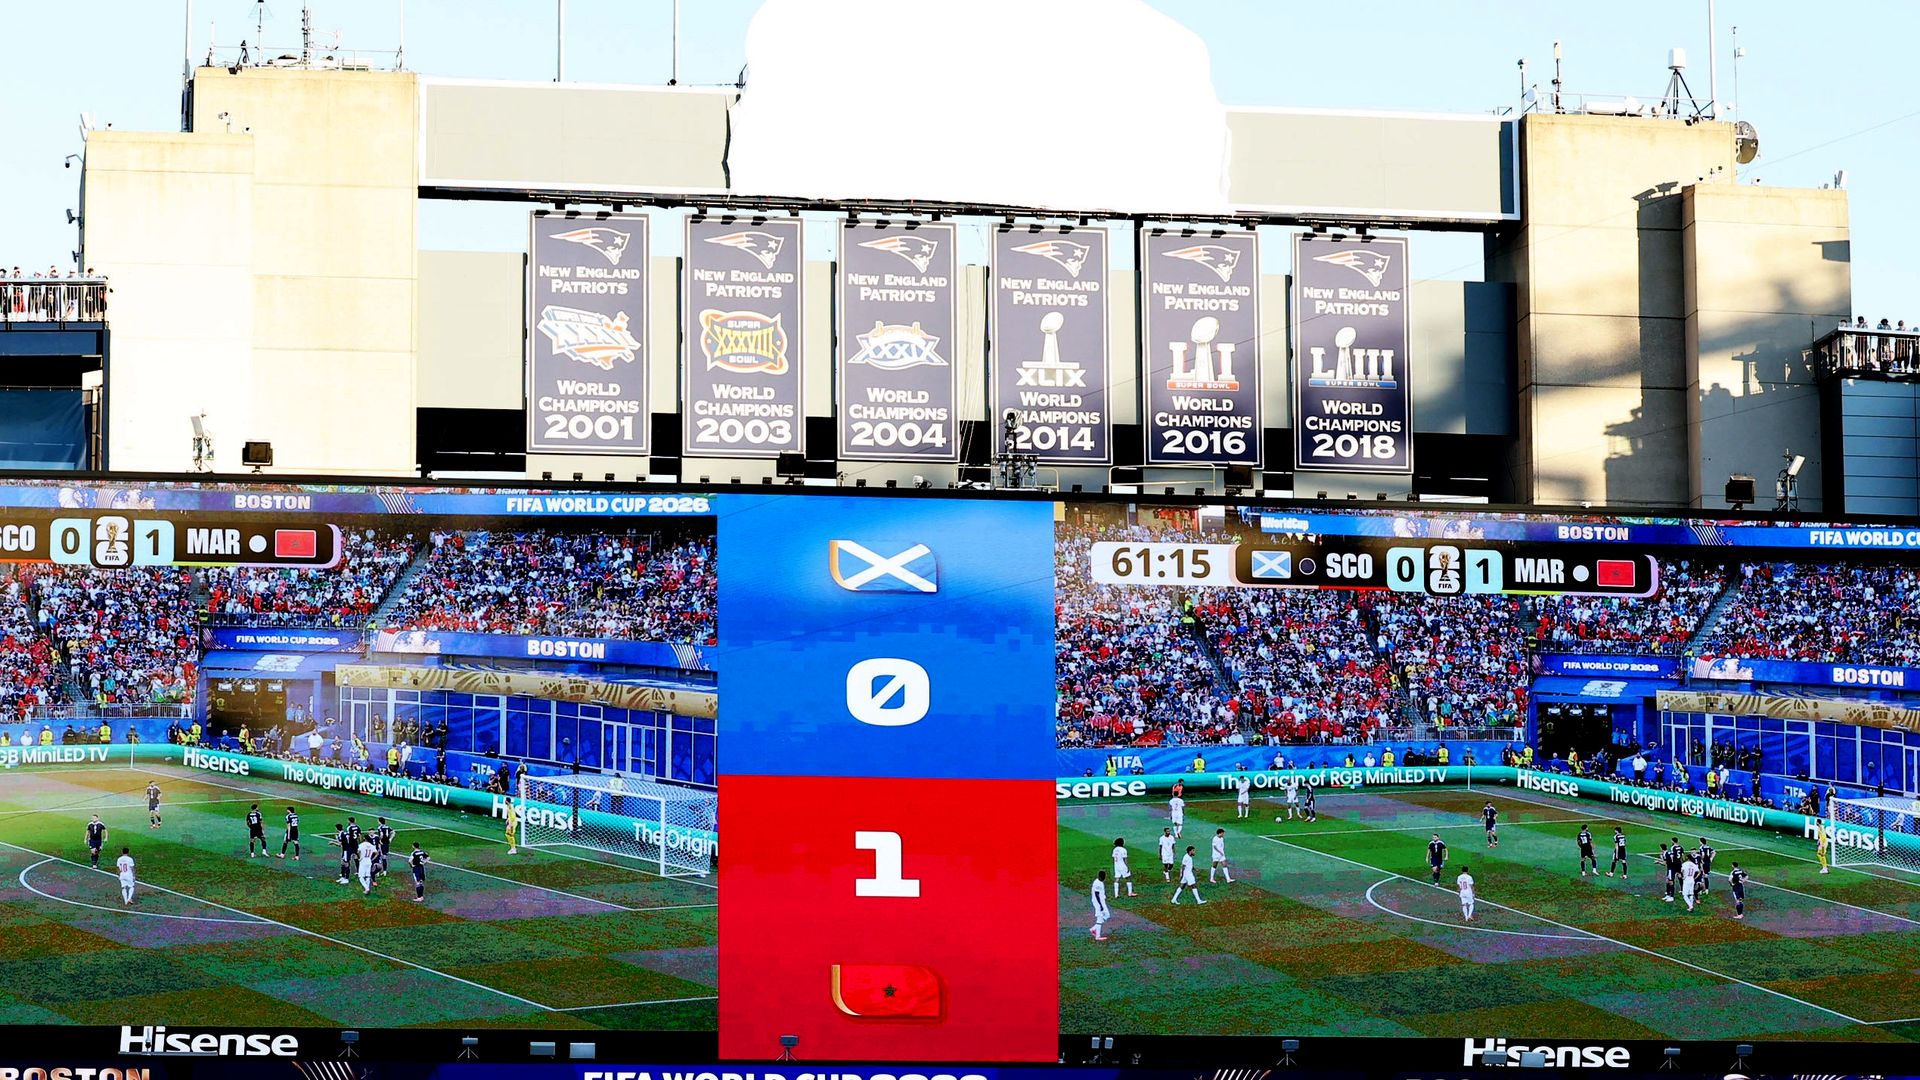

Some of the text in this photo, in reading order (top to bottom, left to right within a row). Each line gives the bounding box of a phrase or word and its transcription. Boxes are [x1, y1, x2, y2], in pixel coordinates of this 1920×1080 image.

[539, 265, 640, 280] NEW ENGLAND
[694, 269, 794, 284] NEW ENGLAND
[848, 273, 947, 288] NEW ENGLAND
[551, 280, 628, 295] PATRIOTS
[705, 284, 782, 299] PATRIOTS
[1001, 277, 1099, 292] NEW ENGLAND
[1153, 283, 1250, 297] NEW ENGLAND
[860, 287, 936, 302] PATRIOTS
[1012, 291, 1088, 306] PATRIOTS
[1304, 287, 1400, 301] NEW ENGLAND
[1165, 296, 1239, 311] PATRIOTS
[1315, 301, 1389, 316] PATRIOTS
[727, 320, 761, 328] SUPER
[729, 355, 759, 364] BOWL
[1015, 368, 1087, 387] XLIX
[557, 380, 621, 396] WORLD
[712, 384, 775, 400] WORLD
[866, 388, 929, 403] WORLD
[539, 397, 639, 414] CHAMPIONS
[1020, 391, 1082, 407] WORLD
[1172, 396, 1234, 411] WORLD
[694, 401, 794, 417] CHAMPIONS
[849, 404, 947, 421] CHAMPIONS
[1322, 400, 1383, 416] WORLD
[544, 415, 634, 440] 2001
[1155, 412, 1252, 428] CHAMPIONS
[1305, 416, 1401, 432] CHAMPIONS
[696, 418, 792, 444] 2003
[850, 422, 947, 448] 2004
[1013, 426, 1095, 451] 2014
[1161, 430, 1247, 455] 2016
[1312, 433, 1396, 459] 2018
[234, 494, 311, 510] BOSTON
[506, 497, 710, 514] FIFA WORLD CUP 2026
[0, 524, 81, 555] CO 0
[1558, 525, 1629, 541] BOSTON
[1809, 530, 1844, 545] FIFA
[1845, 531, 1904, 546] WORLD
[146, 528, 240, 556] 1 MAR
[1111, 547, 1211, 579] 61:15
[1326, 552, 1415, 583] SCO 0
[1476, 558, 1565, 585] 1 MAR
[236, 635, 339, 645] FIFA WORLD CUP 2026
[527, 639, 605, 659] BOSTON
[1563, 661, 1659, 672] FIFA WORLD CUP 2026
[1833, 667, 1905, 687] BOSTON
[846, 657, 930, 726] 0
[22, 747, 86, 764] MiniLED
[88, 747, 109, 762] TV
[183, 749, 449, 806] Hisense The Origin of RGB MiniLED TV
[1254, 772, 1305, 791] Origin
[1309, 770, 1327, 787] of
[1330, 770, 1363, 785] RGB
[1366, 768, 1425, 785] MiniLED
[1429, 769, 1448, 783] TV
[1517, 770, 1766, 827] Hisense The Origin of RGB MiniLED TV
[492, 795, 718, 857] Hsense The Origin
[1804, 816, 1888, 852] Hsense
[855, 831, 920, 897] 1
[119, 1025, 299, 1056] Hisense
[1463, 1038, 1631, 1068] Hisense
